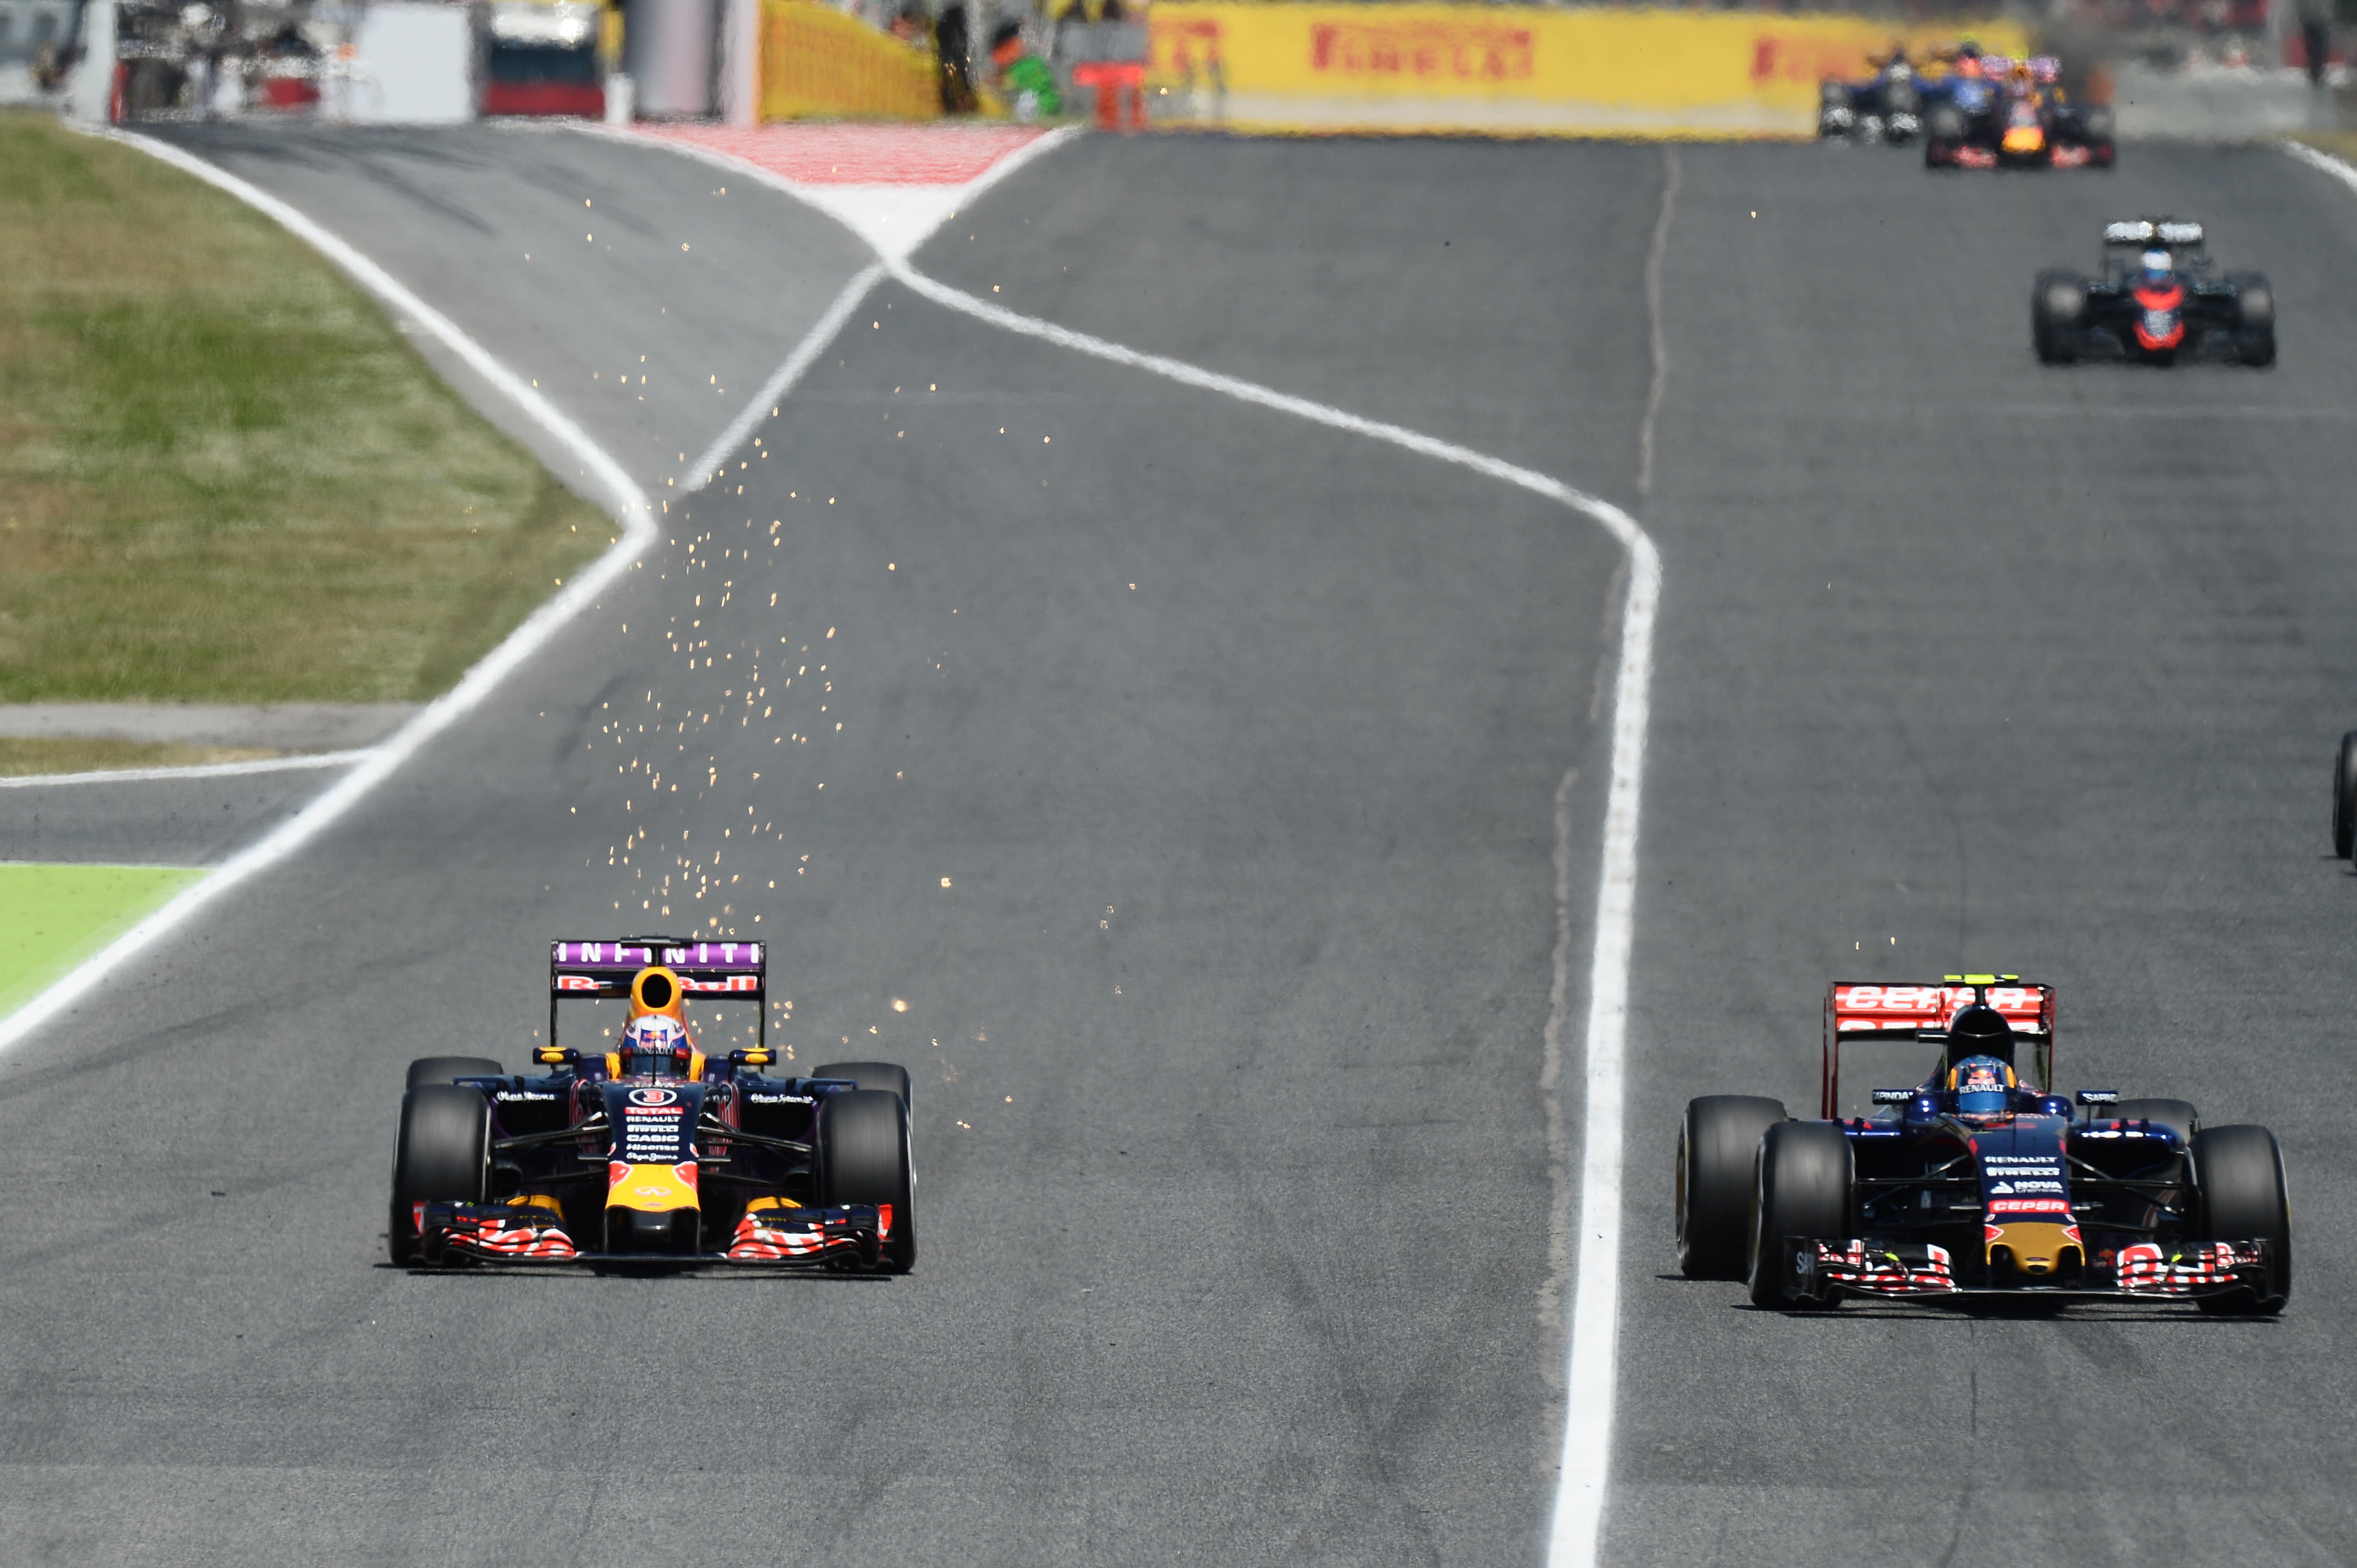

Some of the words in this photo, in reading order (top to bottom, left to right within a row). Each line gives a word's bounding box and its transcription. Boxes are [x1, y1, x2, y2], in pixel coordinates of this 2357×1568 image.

[1845, 987, 2025, 1009] CEPSA
[1959, 1085, 2005, 1094] RENAULT
[643, 1090, 664, 1103] 3
[1986, 1167, 2059, 1176] PIRELLI
[1993, 1201, 2065, 1211] CEPSA
